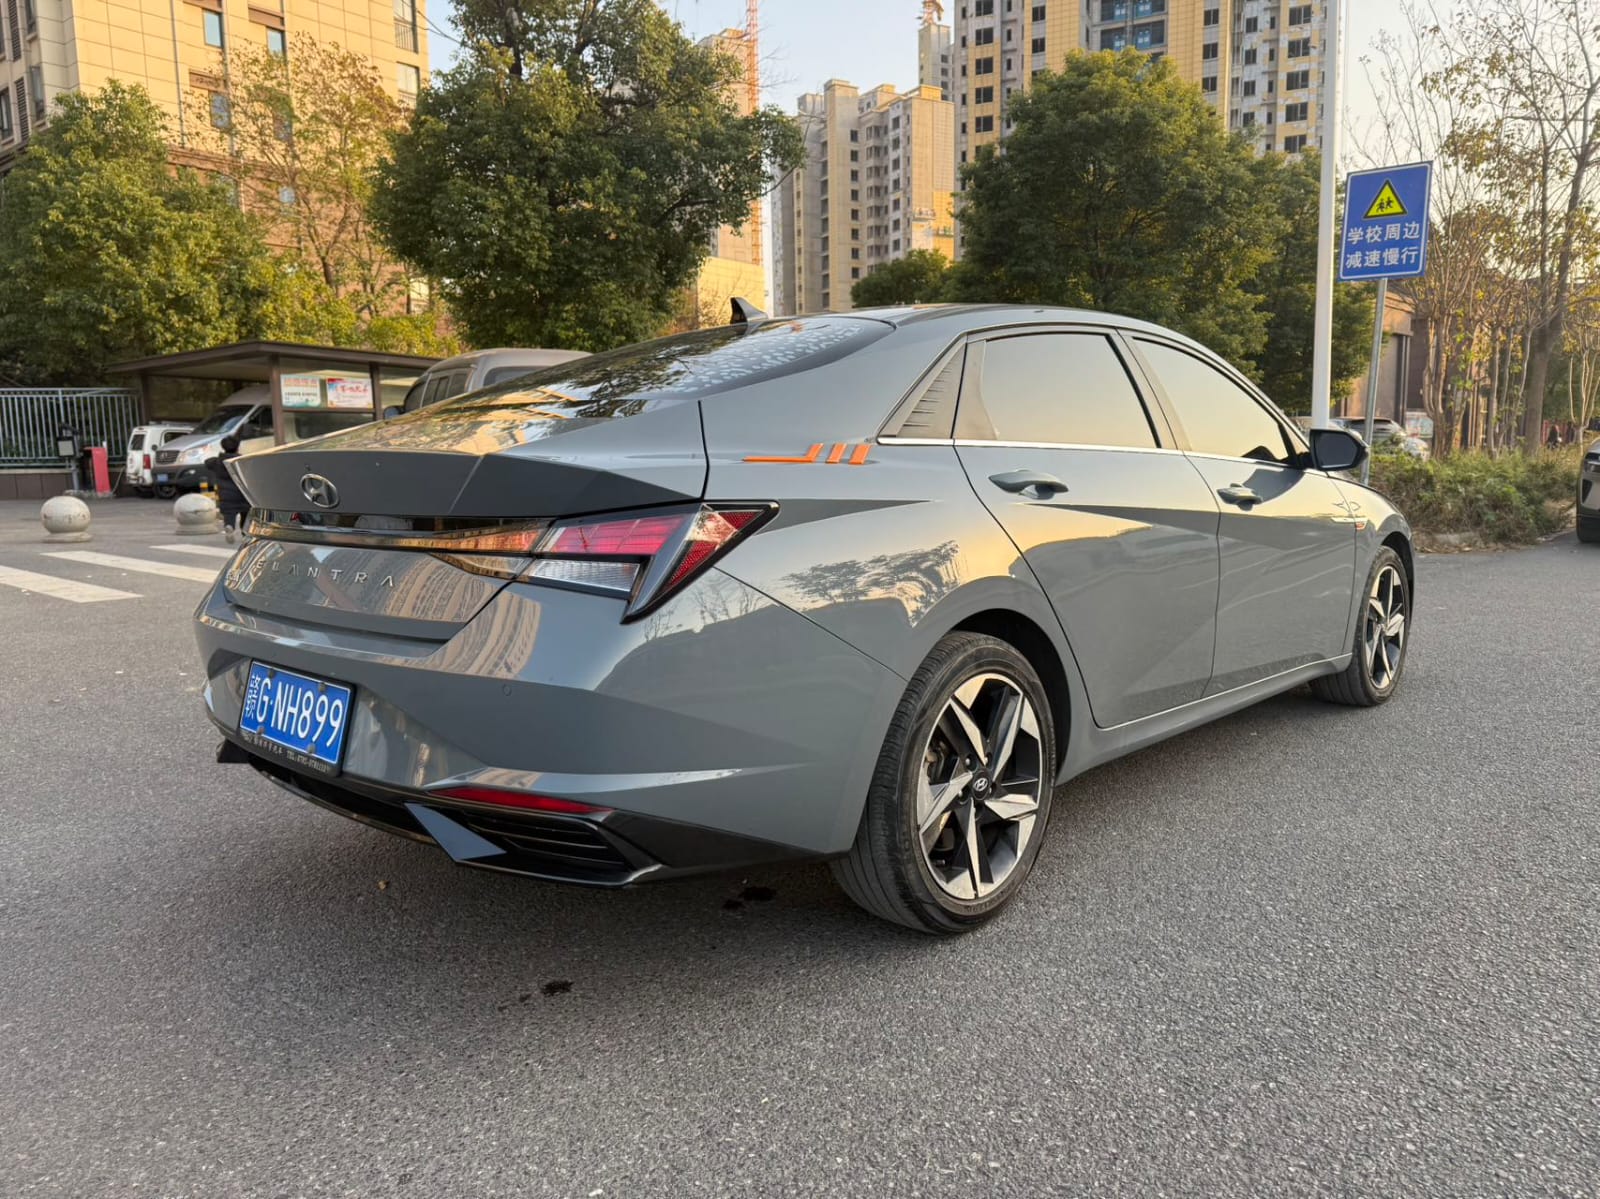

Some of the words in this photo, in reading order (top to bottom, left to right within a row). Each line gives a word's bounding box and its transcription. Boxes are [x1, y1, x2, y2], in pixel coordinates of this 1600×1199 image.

[1347, 221, 1420, 245] 学校周边
[1345, 246, 1419, 268] 减速慢行
[255, 557, 394, 588] ELANTRA
